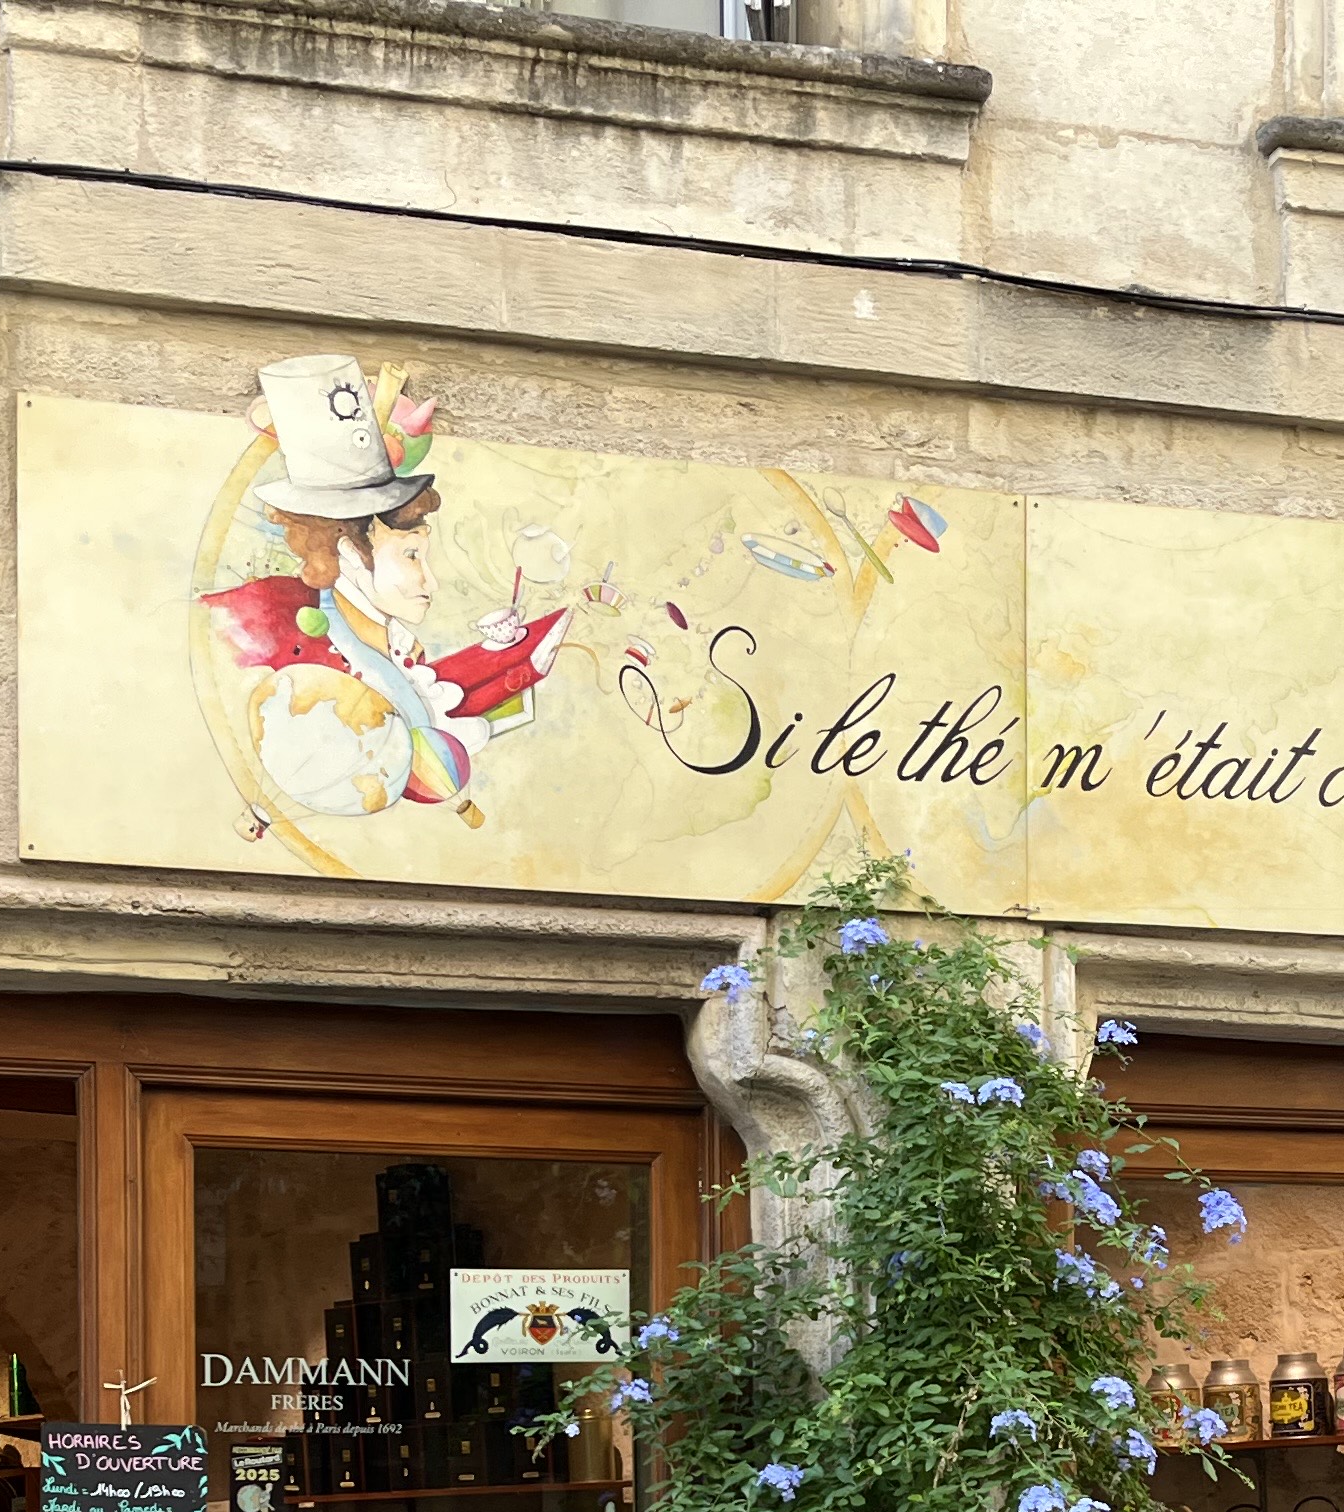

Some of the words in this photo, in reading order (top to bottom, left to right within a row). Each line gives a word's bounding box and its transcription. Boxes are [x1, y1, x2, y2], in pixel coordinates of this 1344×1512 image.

[617, 624, 804, 777] Si
[810, 671, 888, 778] le
[897, 684, 1021, 786] thé
[470, 1286, 528, 1314] BONNAT
[552, 1287, 575, 1299] SES
[201, 1354, 411, 1387] DAMMANN
[271, 1392, 344, 1411] FRÈRES
[1289, 1402, 1304, 1412] TEA
[215, 1422, 273, 1433] Marchands
[307, 1423, 314, 1433] à
[316, 1423, 341, 1434] Paris
[343, 1423, 374, 1437] depuis
[378, 1423, 403, 1434] 1692
[48, 1434, 142, 1450] HORAIRES
[76, 1454, 203, 1472] D'OUVERTURE
[236, 1469, 280, 1480] 2025
[42, 1476, 79, 1494] Lundi
